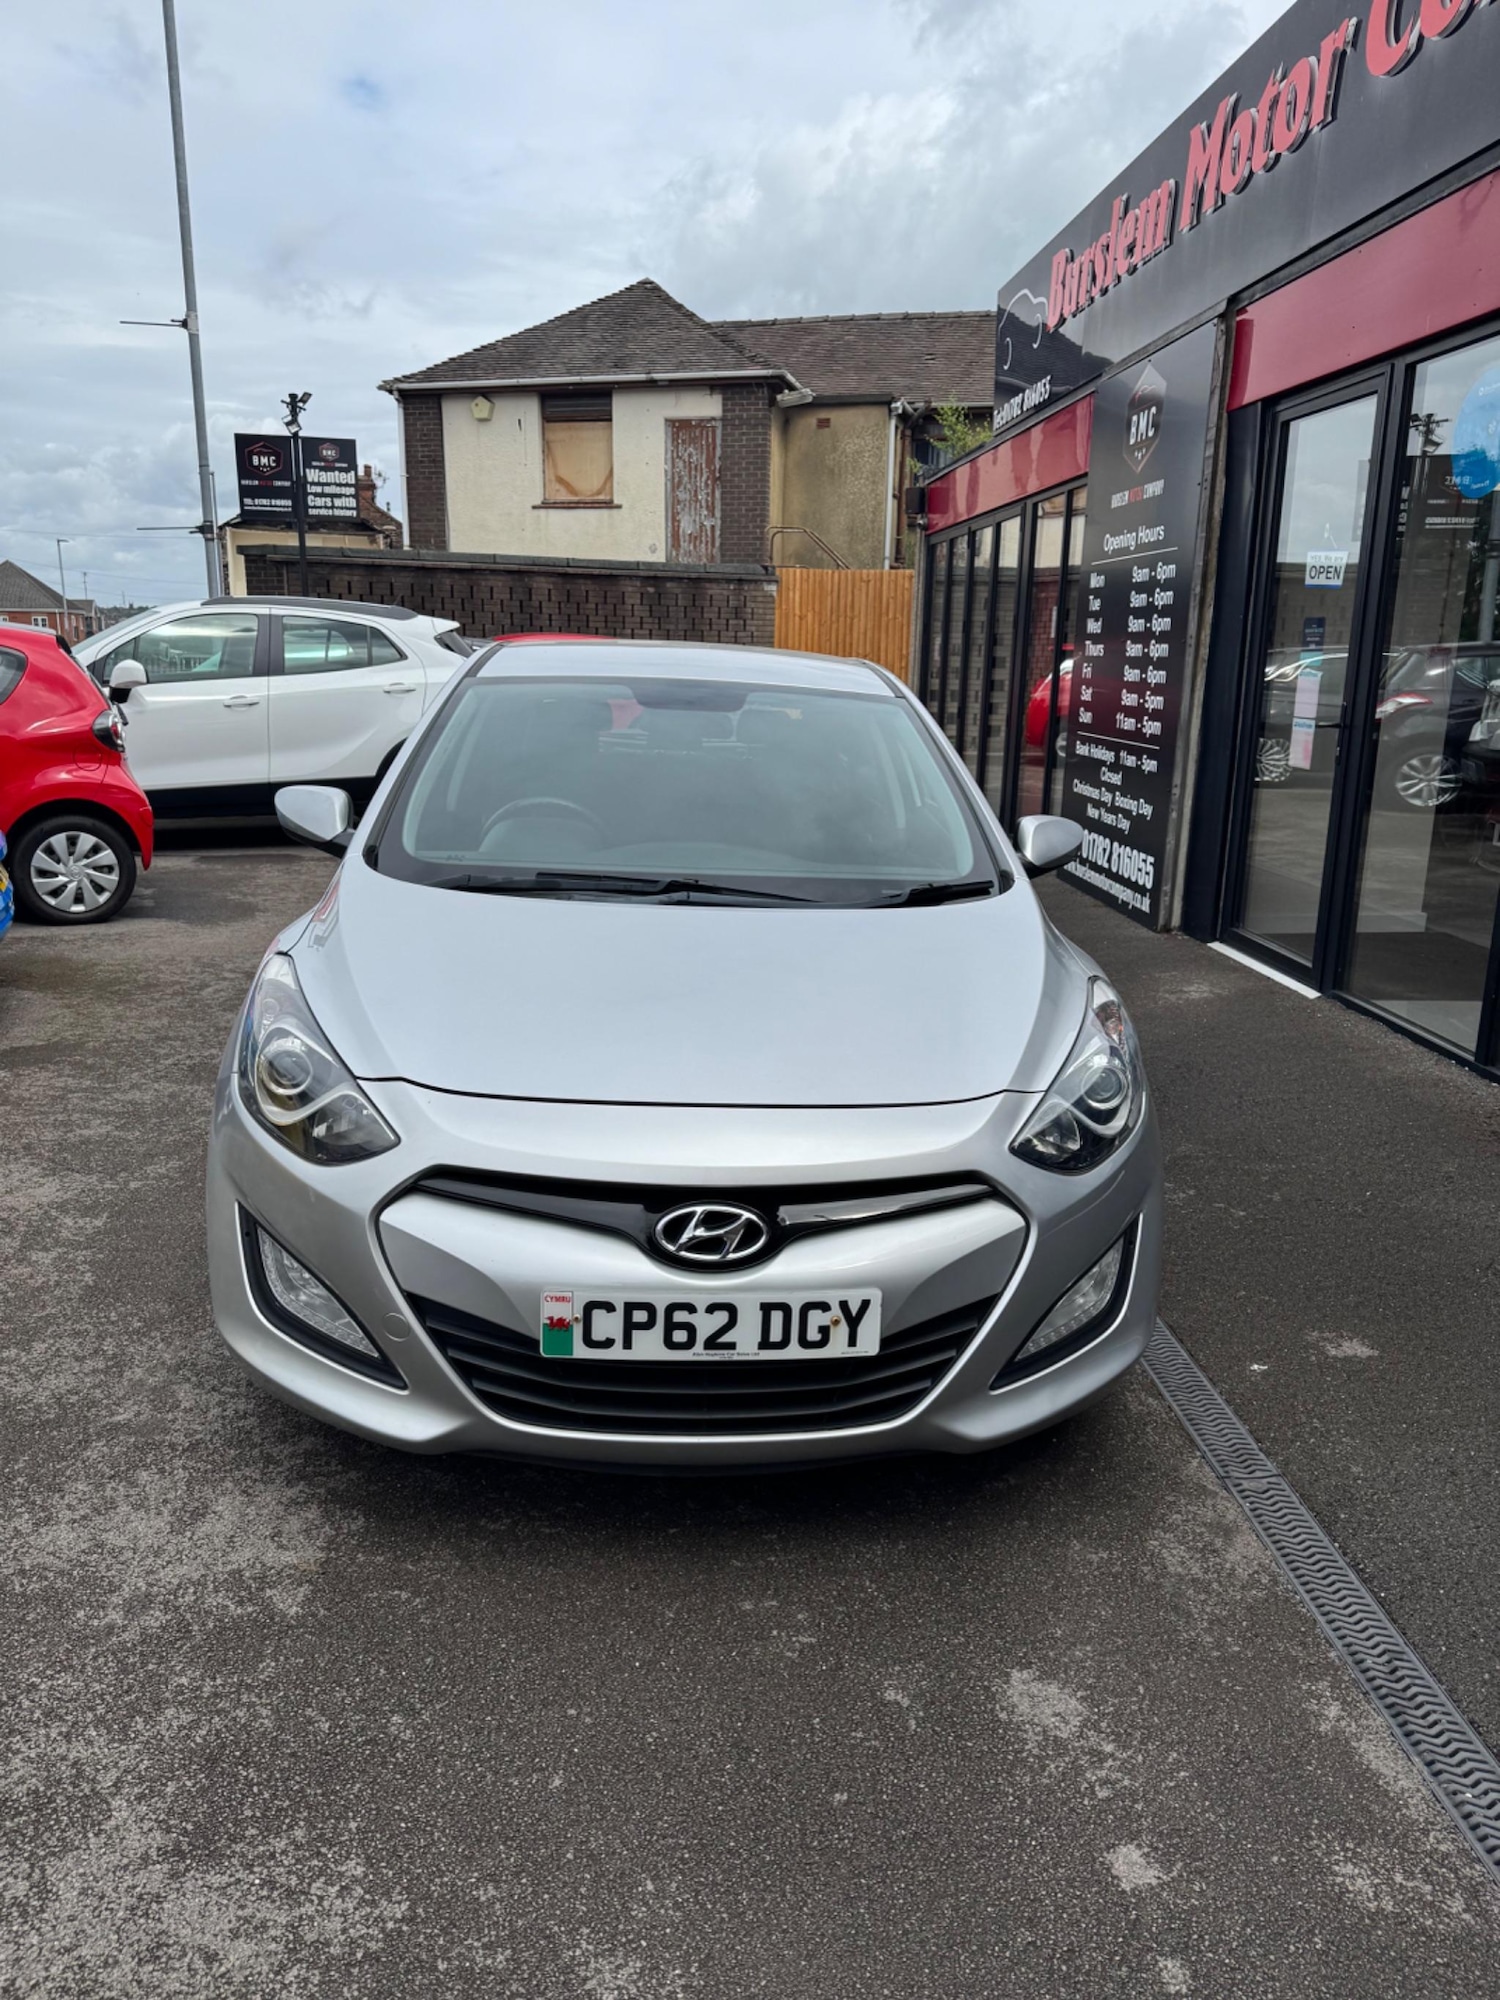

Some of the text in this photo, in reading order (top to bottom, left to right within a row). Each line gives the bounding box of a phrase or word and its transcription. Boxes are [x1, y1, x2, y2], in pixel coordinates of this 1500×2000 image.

[1046, 178, 1175, 332] Burslem
[1179, 17, 1357, 232] Motor
[1129, 406, 1157, 445] BMC
[252, 455, 277, 467] BMC
[305, 468, 356, 484] Wanted
[307, 483, 356, 495] Low mileage
[307, 494, 357, 508] Cars with
[308, 507, 357, 518] service history
[1104, 525, 1165, 554] Opening Hours
[1090, 572, 1105, 588] Mon
[1132, 565, 1150, 582] 9am
[1156, 562, 1176, 584] 6pm
[1309, 565, 1342, 580] OPEN
[1088, 595, 1101, 611] Tue
[1130, 590, 1147, 608] 9am
[1154, 588, 1174, 610] 6pm
[1086, 618, 1102, 634] Wed
[1127, 615, 1145, 632] 9am
[1152, 613, 1171, 635] 6pm
[1085, 641, 1104, 656] Thurs
[1125, 640, 1143, 657] 9am
[1149, 639, 1169, 661] 6pm
[1082, 663, 1093, 679] Fri
[1124, 665, 1140, 682] 9am
[1147, 665, 1166, 687] 6pm
[1081, 685, 1093, 701] Sat
[1121, 689, 1138, 707] 9am
[1144, 691, 1164, 713] 5pm
[1079, 707, 1093, 724] Sun
[1116, 712, 1136, 731] 11am
[1142, 716, 1161, 738] 5pm
[1075, 740, 1089, 756] Bank
[1090, 743, 1115, 765] Holidays
[1119, 750, 1137, 767] 11am
[1141, 754, 1158, 774] 5pm
[1100, 766, 1122, 785] Closed
[1072, 778, 1153, 820] Christmas Day Boxing Day
[1086, 802, 1131, 835] New Years Day
[1082, 829, 1155, 889] 01782 816055
[582, 1299, 871, 1351] CP62 DGY
